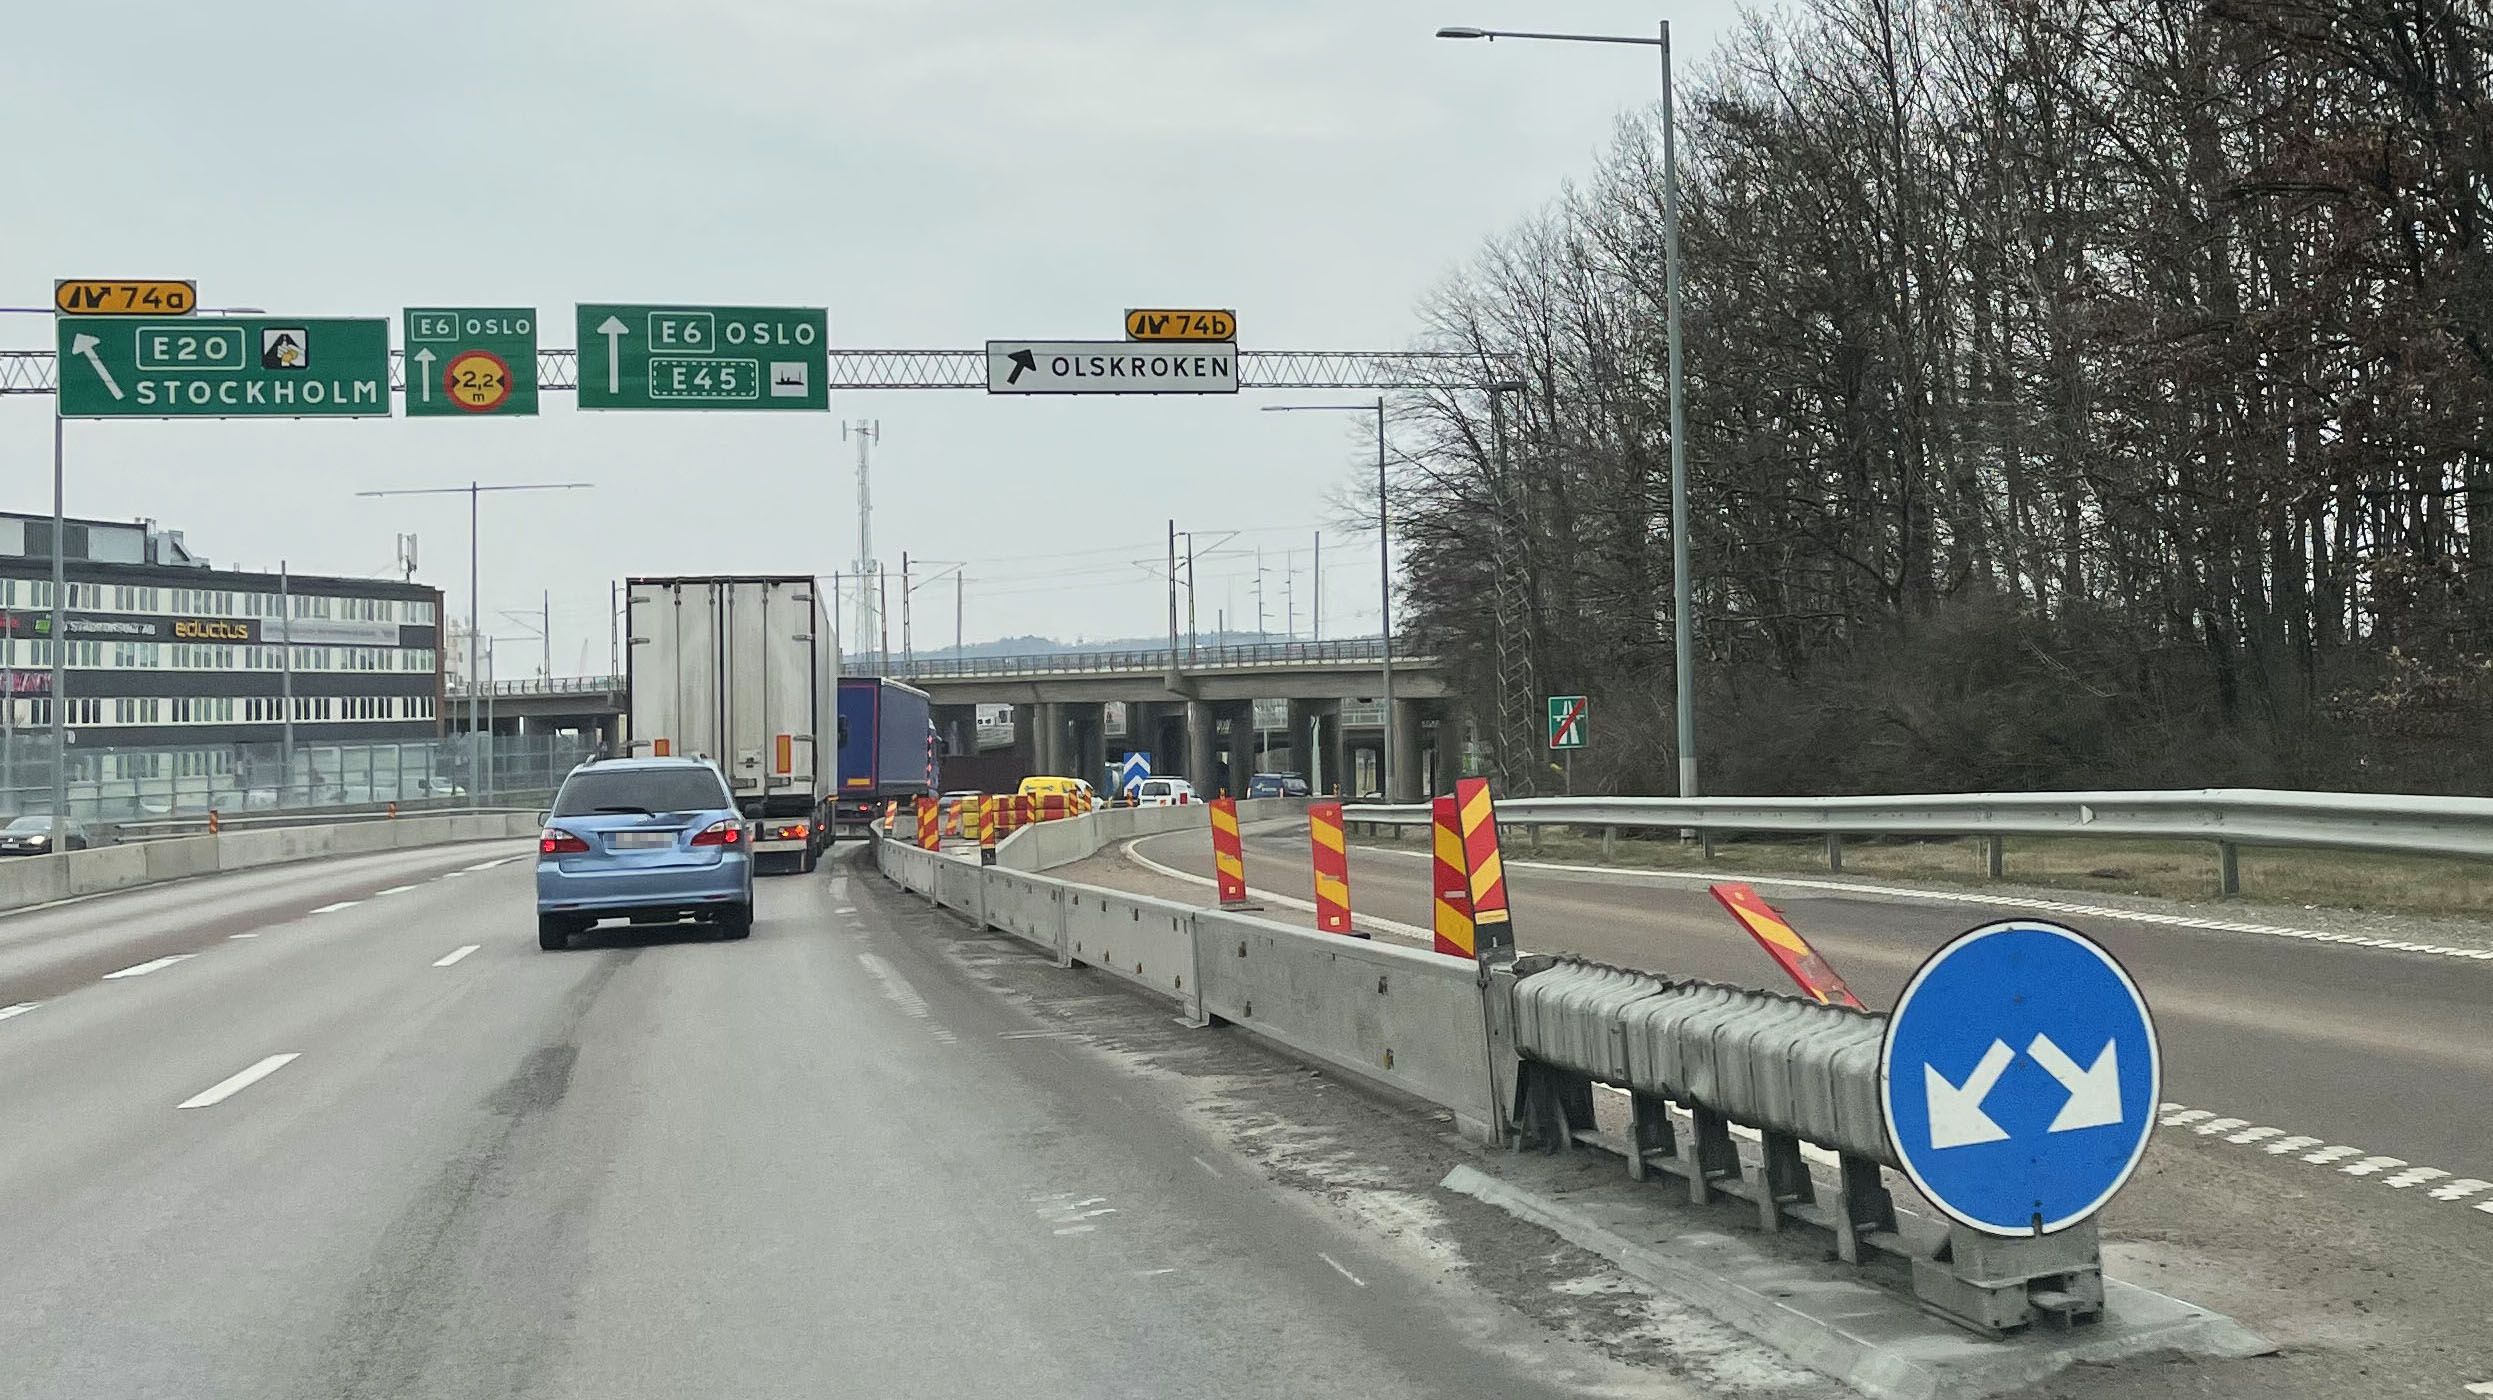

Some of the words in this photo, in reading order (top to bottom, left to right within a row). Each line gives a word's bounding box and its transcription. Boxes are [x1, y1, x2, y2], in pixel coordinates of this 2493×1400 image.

[120, 287, 184, 309] 74a
[421, 319, 449, 335] E6
[466, 319, 530, 335] OSLO
[662, 320, 702, 344] E6
[725, 322, 815, 345] OSLO
[1176, 315, 1227, 335] 74b
[153, 337, 228, 360] E20
[1051, 356, 1229, 377] OLSKROKEN
[462, 371, 494, 391] 2,2
[672, 367, 736, 390] E45
[136, 380, 377, 405] STOCKHOLM
[472, 393, 485, 402] m
[175, 620, 248, 639] eductus
